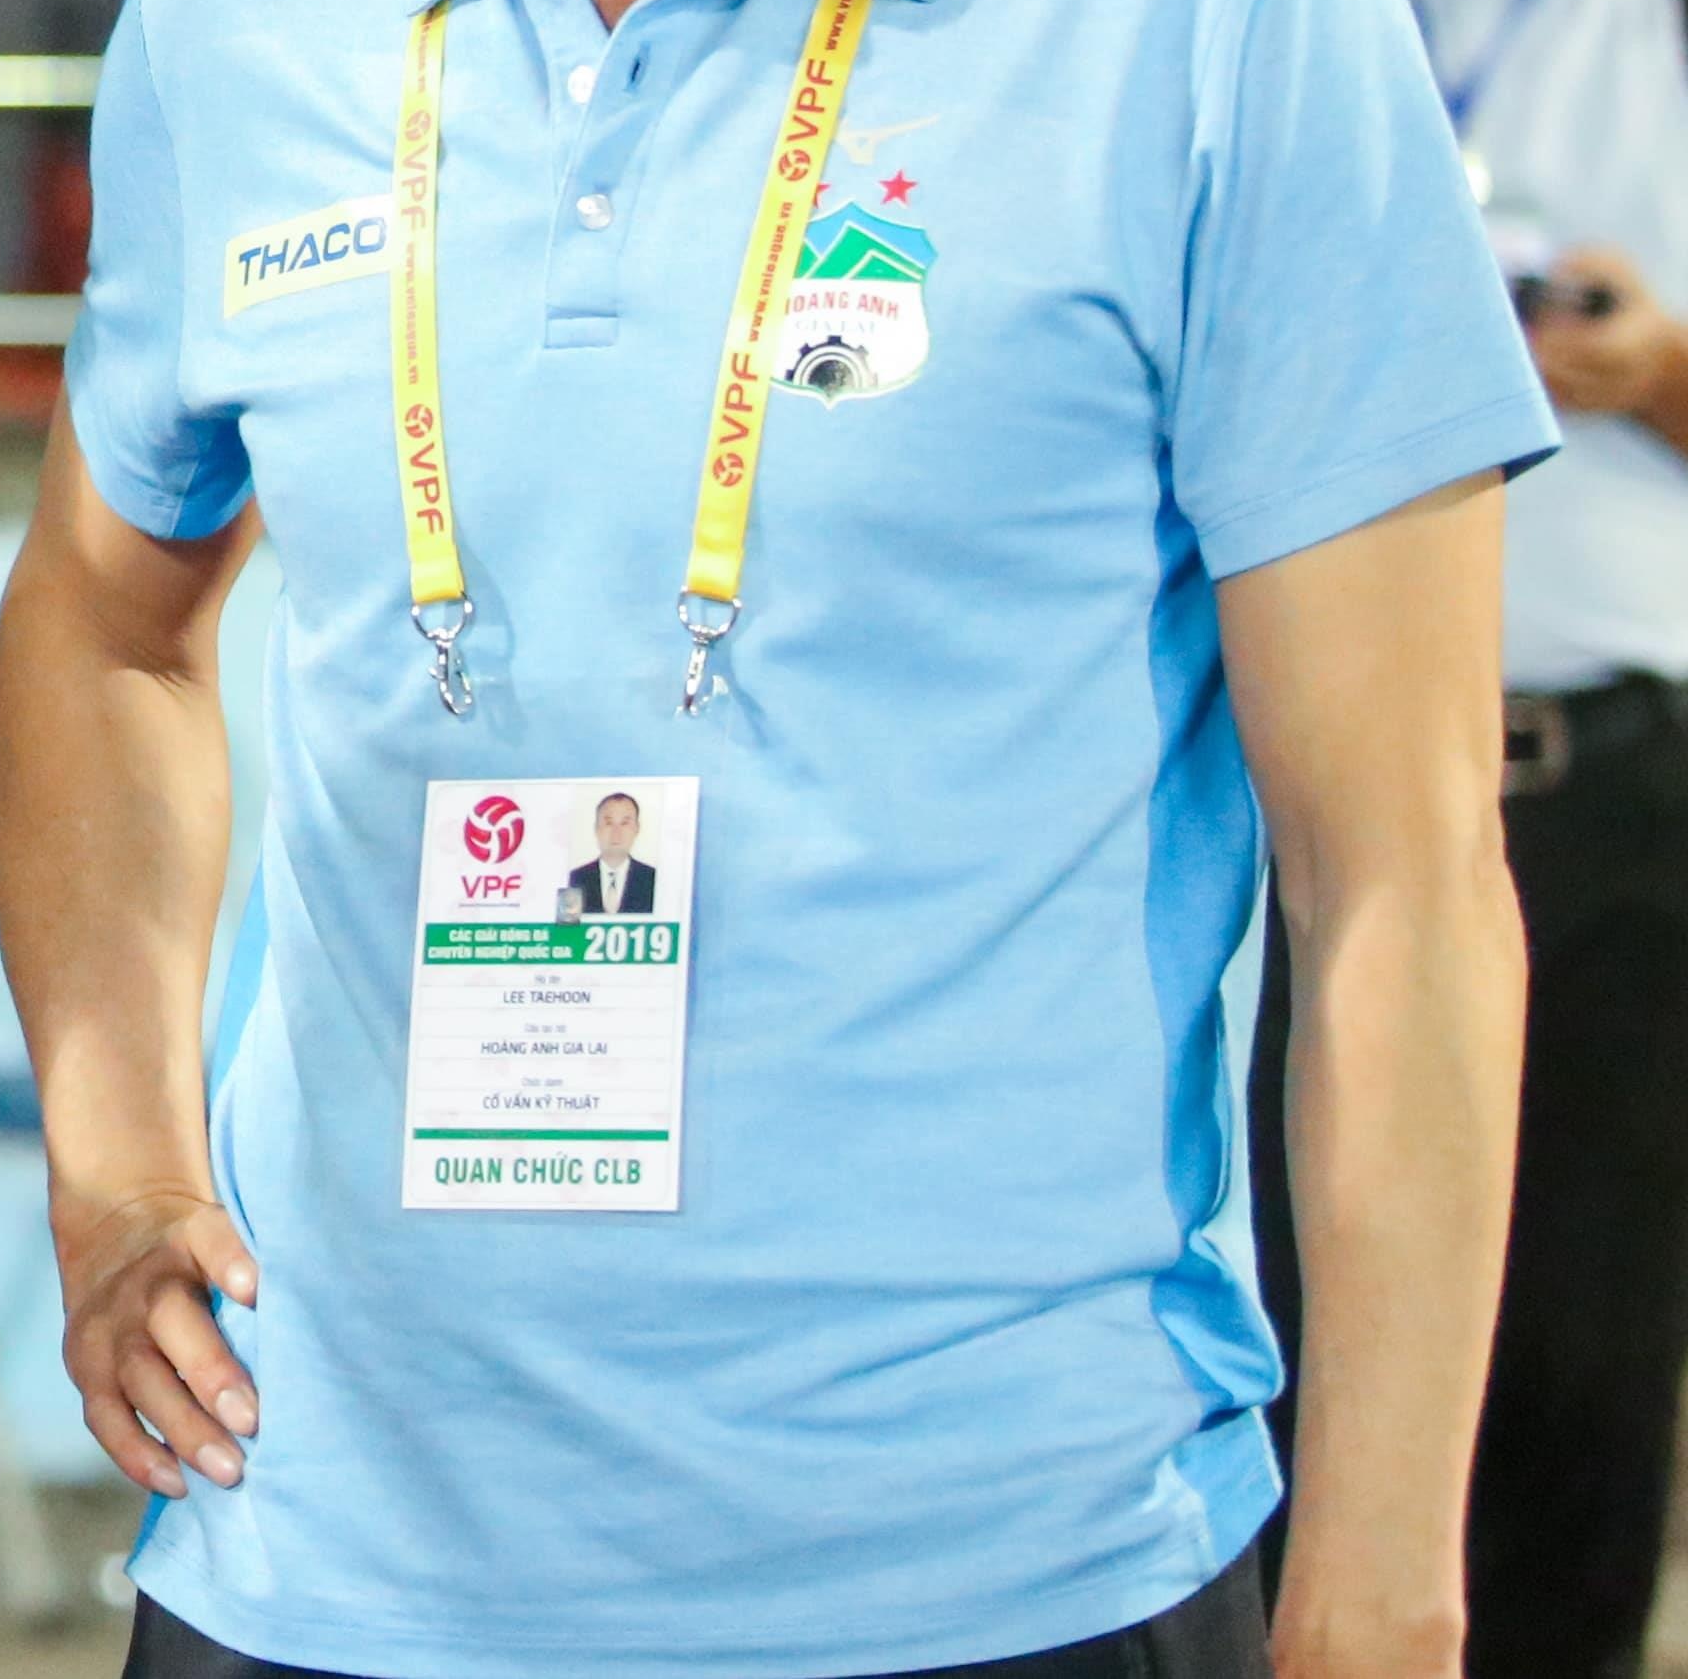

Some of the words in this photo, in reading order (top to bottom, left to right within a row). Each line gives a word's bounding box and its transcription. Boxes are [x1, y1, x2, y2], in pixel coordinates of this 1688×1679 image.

[786, 58, 833, 142] VPF
[401, 143, 429, 230] VPF
[238, 216, 387, 286] THACO
[857, 293, 900, 320] ANH
[718, 352, 759, 445] VPF
[409, 442, 445, 534] VPF
[460, 875, 522, 898] VPF
[583, 925, 672, 962] 2019
[503, 990, 525, 1004] LEE
[529, 990, 591, 1004] TAEHOON
[530, 1041, 560, 1055] ANH
[563, 1041, 584, 1055] GIA
[587, 1042, 608, 1055] LAI
[434, 1157, 503, 1186] QUAN
[513, 1151, 584, 1185] CHỨC
[593, 1158, 642, 1185] CLB
